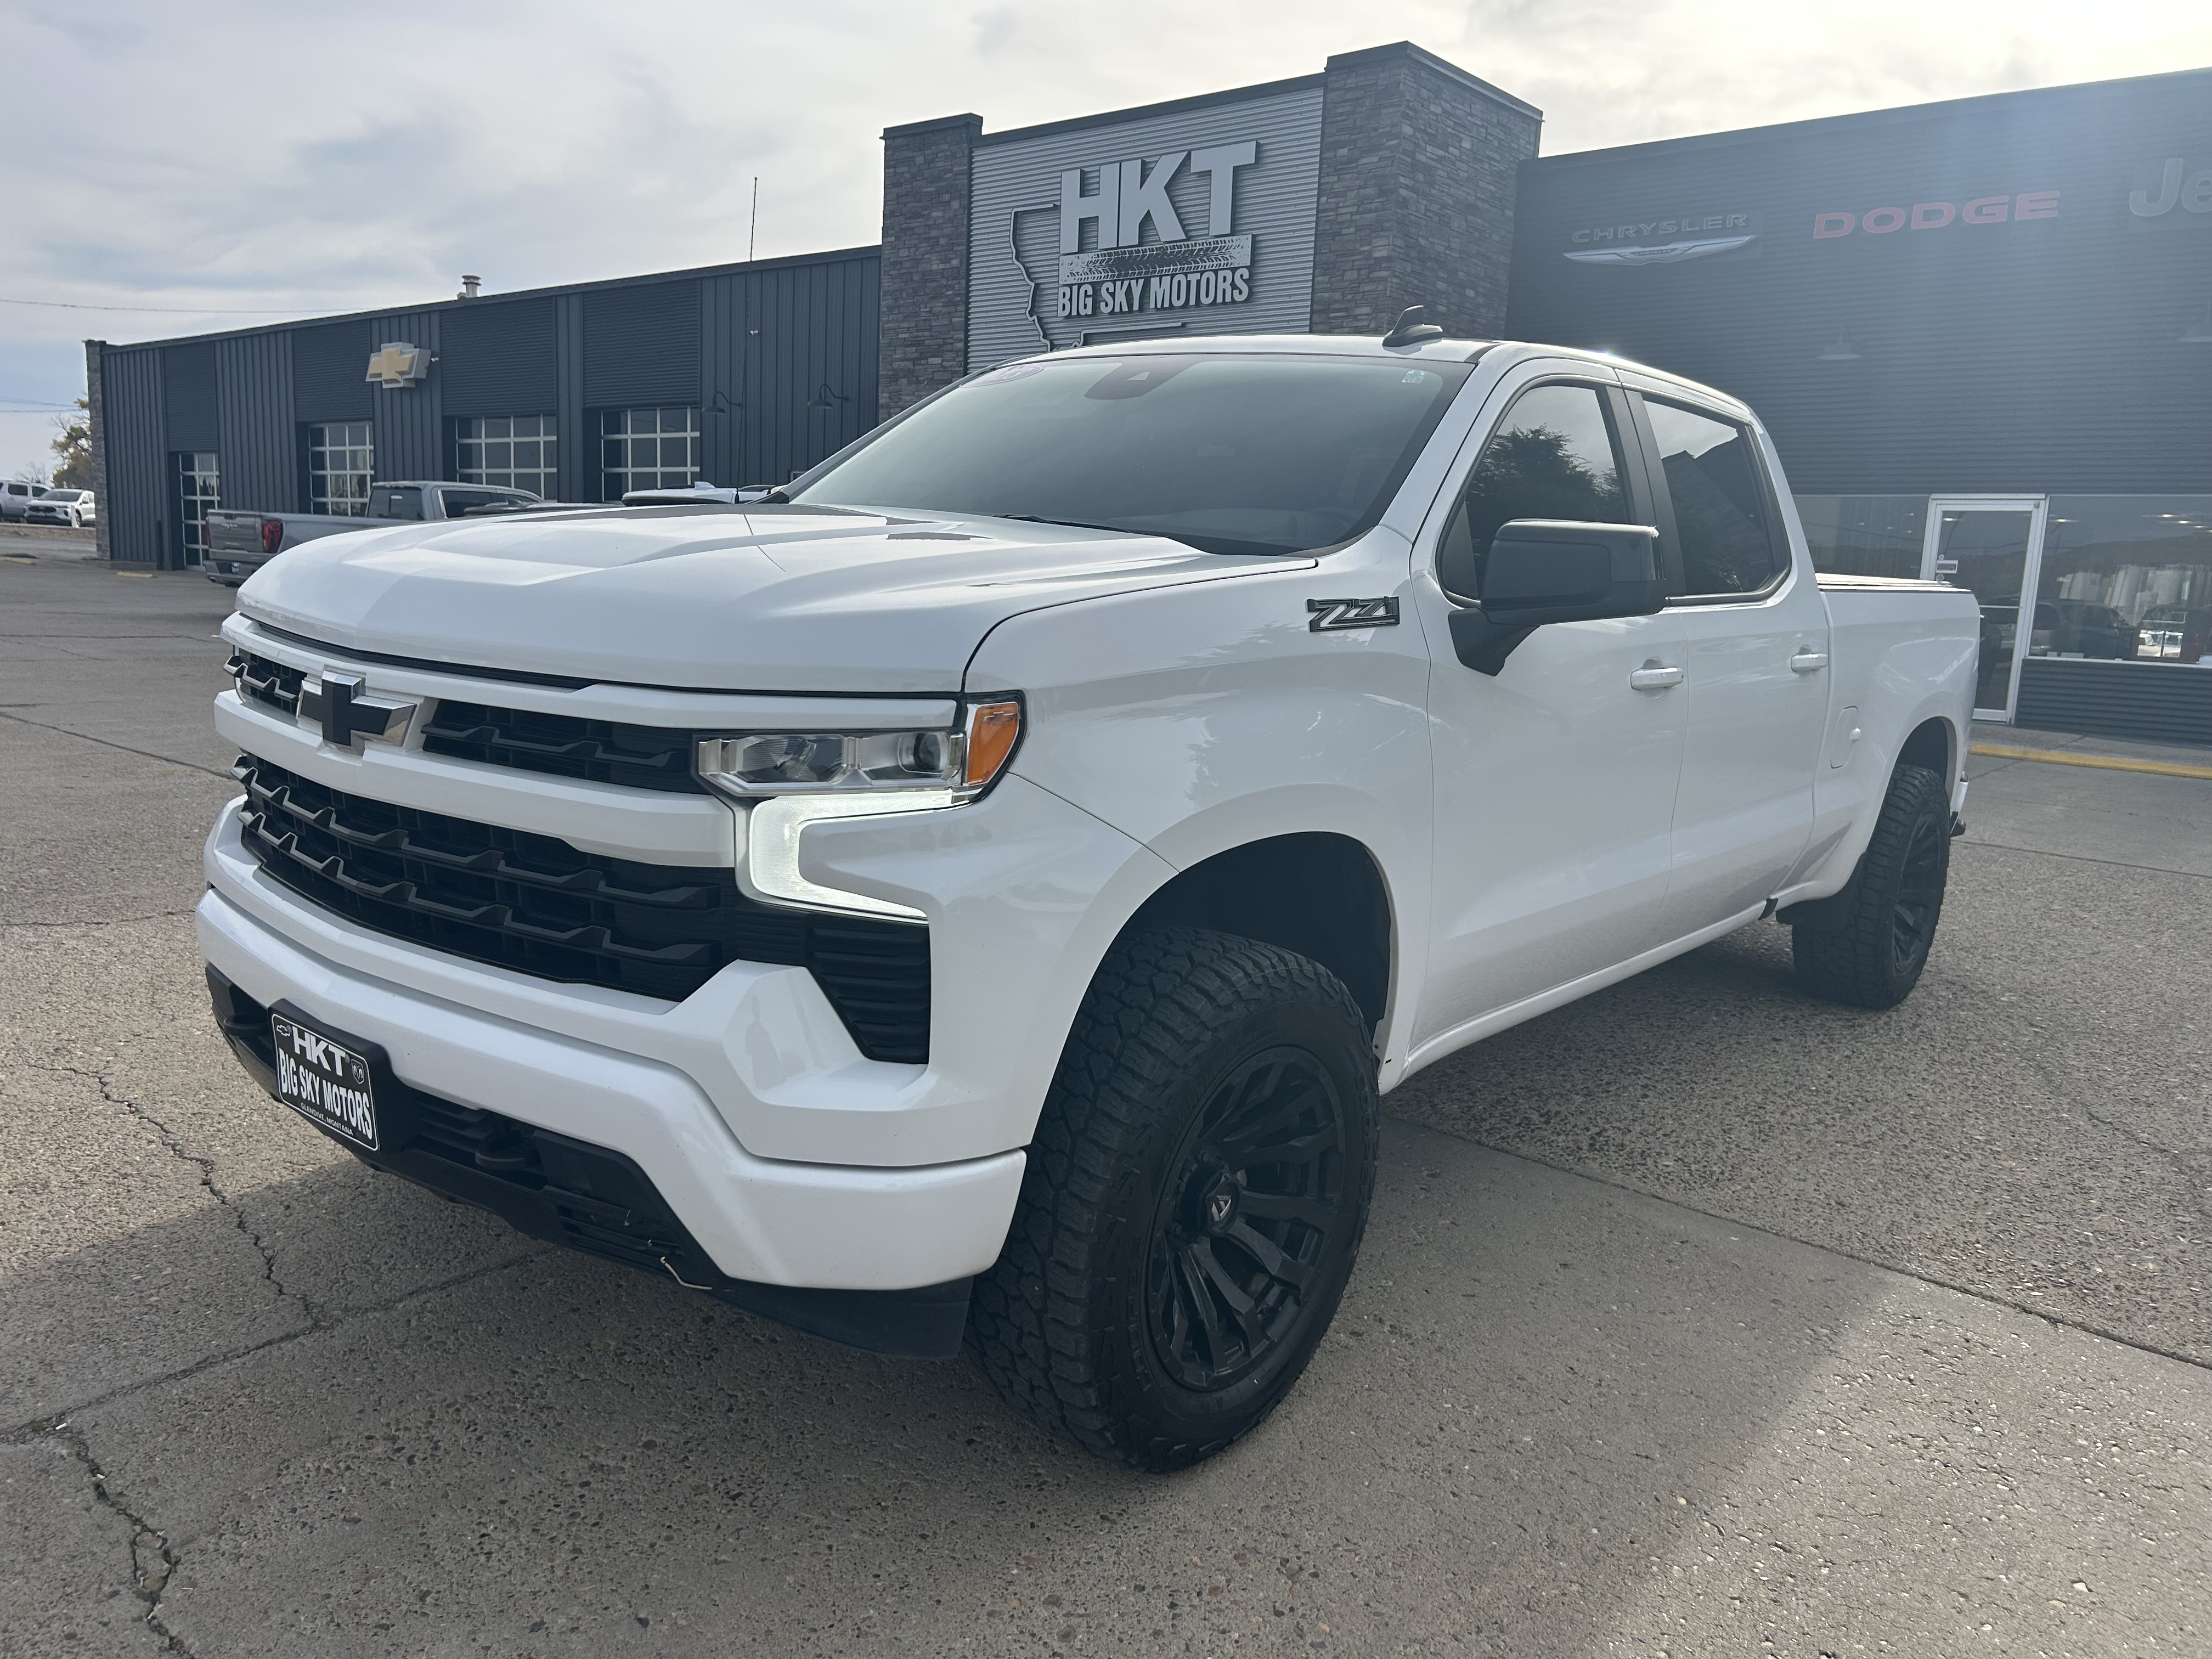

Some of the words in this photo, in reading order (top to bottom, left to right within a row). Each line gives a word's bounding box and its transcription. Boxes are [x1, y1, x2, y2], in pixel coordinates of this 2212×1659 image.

[1059, 140, 1259, 254] HKT
[1813, 190, 2061, 239] DODGE
[1572, 213, 1747, 243] CHRYSLER
[1058, 284, 1093, 317] BIG
[1100, 278, 1144, 314] SKY
[1149, 268, 1250, 309] MOTORS
[1306, 596, 1400, 632] Z71
[292, 1025, 346, 1076] HKT
[279, 1047, 298, 1096] BIG
[299, 1065, 320, 1105] SKY
[323, 1079, 373, 1140] MOTORS
[326, 1116, 353, 1136] MONTANA
